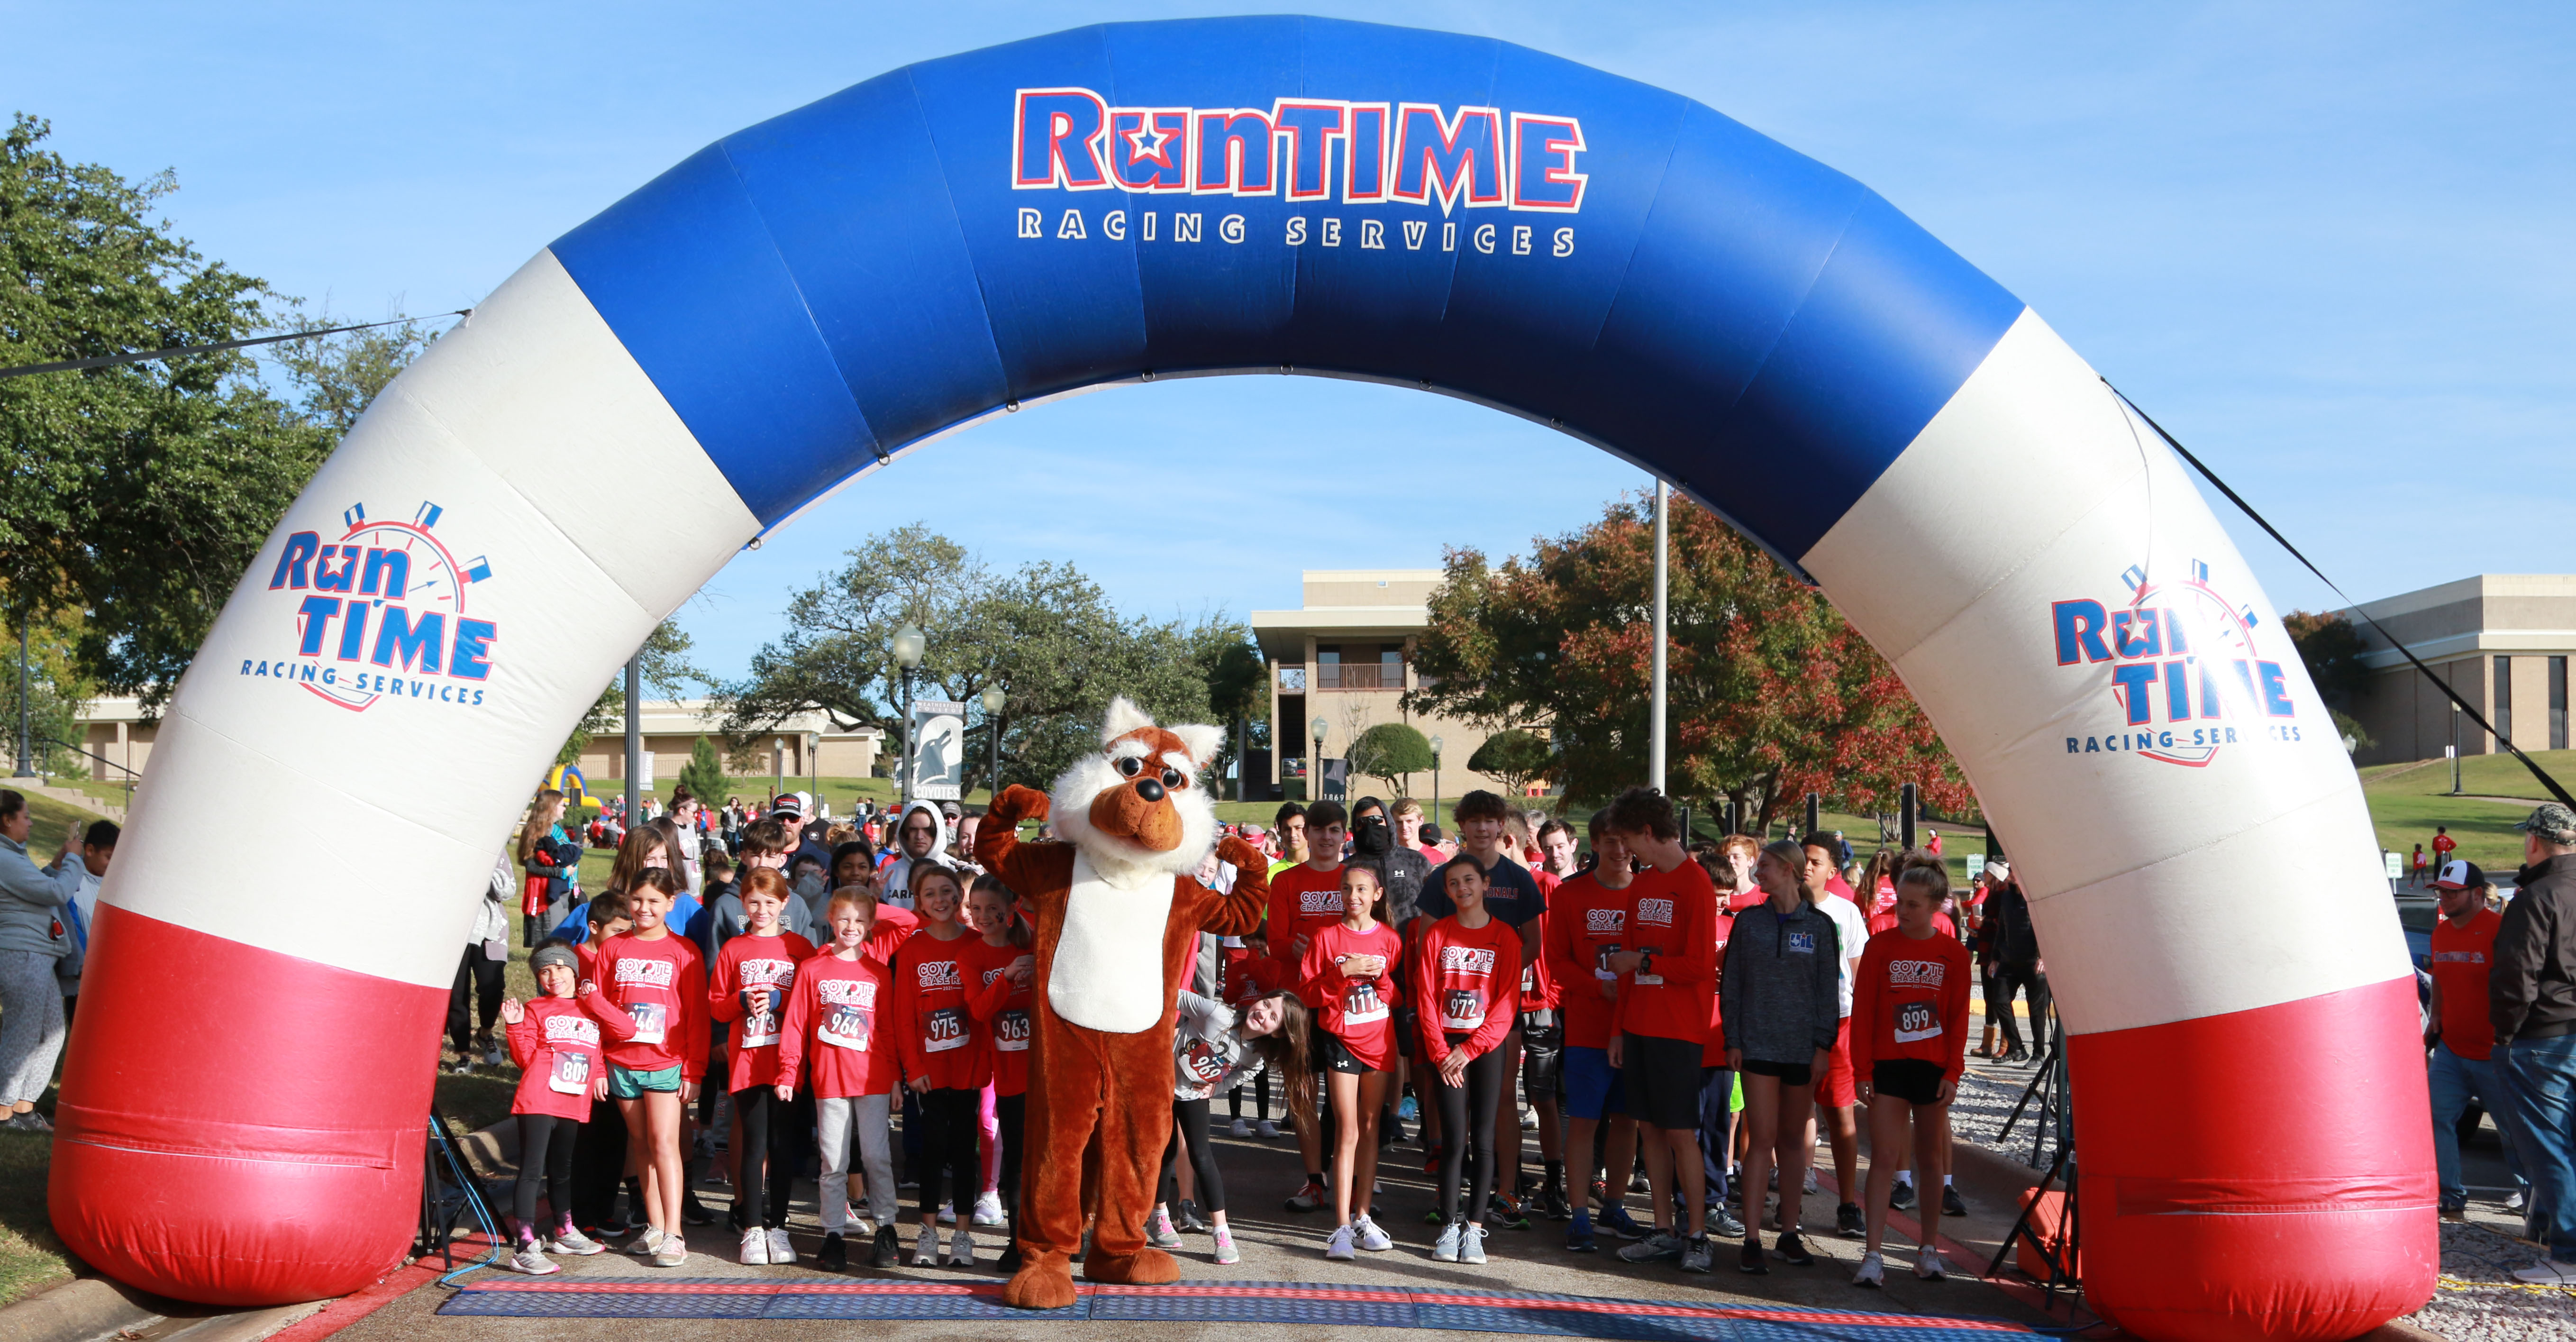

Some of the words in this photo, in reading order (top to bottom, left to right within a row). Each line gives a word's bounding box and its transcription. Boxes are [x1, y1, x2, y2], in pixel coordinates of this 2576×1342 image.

[1012, 87, 1588, 219] RunTIME
[1019, 207, 1245, 245] RACING
[1285, 216, 1575, 257] SERVICES
[269, 531, 411, 600] Run
[298, 595, 497, 681] TIME
[241, 660, 336, 685] RACING
[356, 673, 484, 705] SERVICES
[2066, 731, 2173, 754] RACING
[914, 786, 960, 799] COYOTES
[1301, 903, 1326, 912] CHASE
[1638, 898, 1673, 914] COYOTE
[1587, 922, 1616, 931] CHASE
[1441, 946, 1495, 964] COYOTE
[616, 958, 673, 976] COYOTE
[740, 959, 795, 977] COYOTE
[1442, 959, 1468, 970] CHASE
[1470, 960, 1493, 974] RACE
[1890, 960, 1945, 977] COYOTE
[615, 972, 644, 982] CHASE
[645, 973, 671, 986] RACE
[741, 973, 769, 986] CHASE
[771, 974, 792, 987] RACE
[818, 979, 876, 998] COYOTE
[919, 975, 950, 987] CHASE
[1890, 974, 1919, 983] CHASE
[1921, 975, 1943, 986] RACE
[820, 994, 850, 1005] CHASE
[851, 995, 873, 1008] RACE
[1451, 998, 1476, 1017] 972
[545, 1015, 600, 1035] COYOTE
[746, 1012, 776, 1035] 973
[831, 1012, 860, 1037] 964
[931, 1016, 959, 1039] 975
[1001, 1018, 1030, 1039] 963
[1902, 1009, 1929, 1030] 899
[546, 1028, 577, 1040] CHASE
[578, 1031, 600, 1045] RACE
[562, 1061, 589, 1083] 809
[1192, 1056, 1221, 1079] 969
